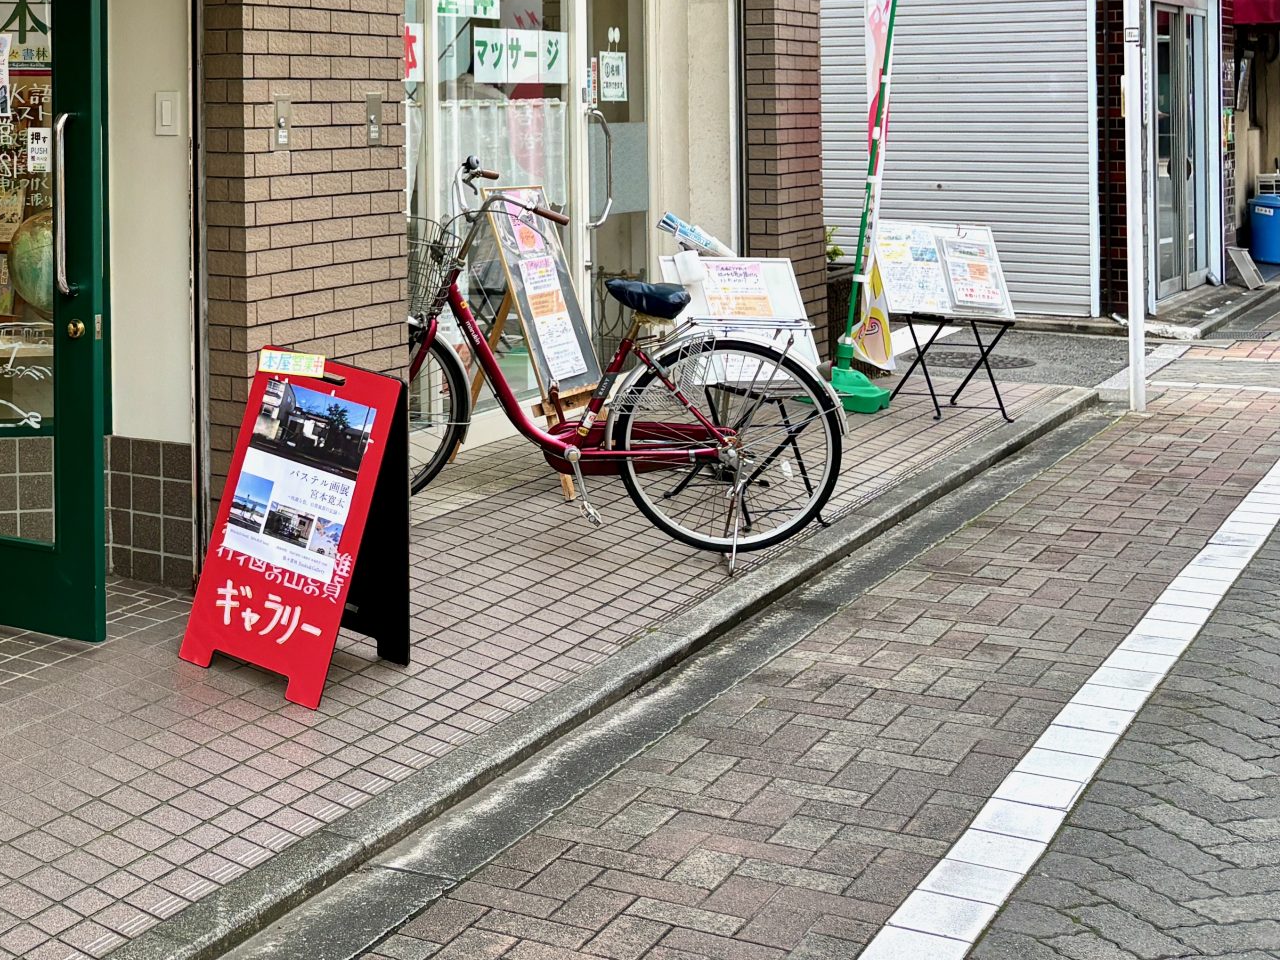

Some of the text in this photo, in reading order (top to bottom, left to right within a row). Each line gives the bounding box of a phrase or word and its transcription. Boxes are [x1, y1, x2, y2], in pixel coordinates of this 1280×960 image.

[9, 47, 48, 61] 々書林
[474, 37, 559, 70] マッサージ
[31, 131, 48, 145] 押す
[30, 147, 48, 155] PUSH
[263, 352, 323, 373] 本屋営業中
[290, 470, 350, 497] パステル画展
[215, 579, 322, 645] ギャラリー
